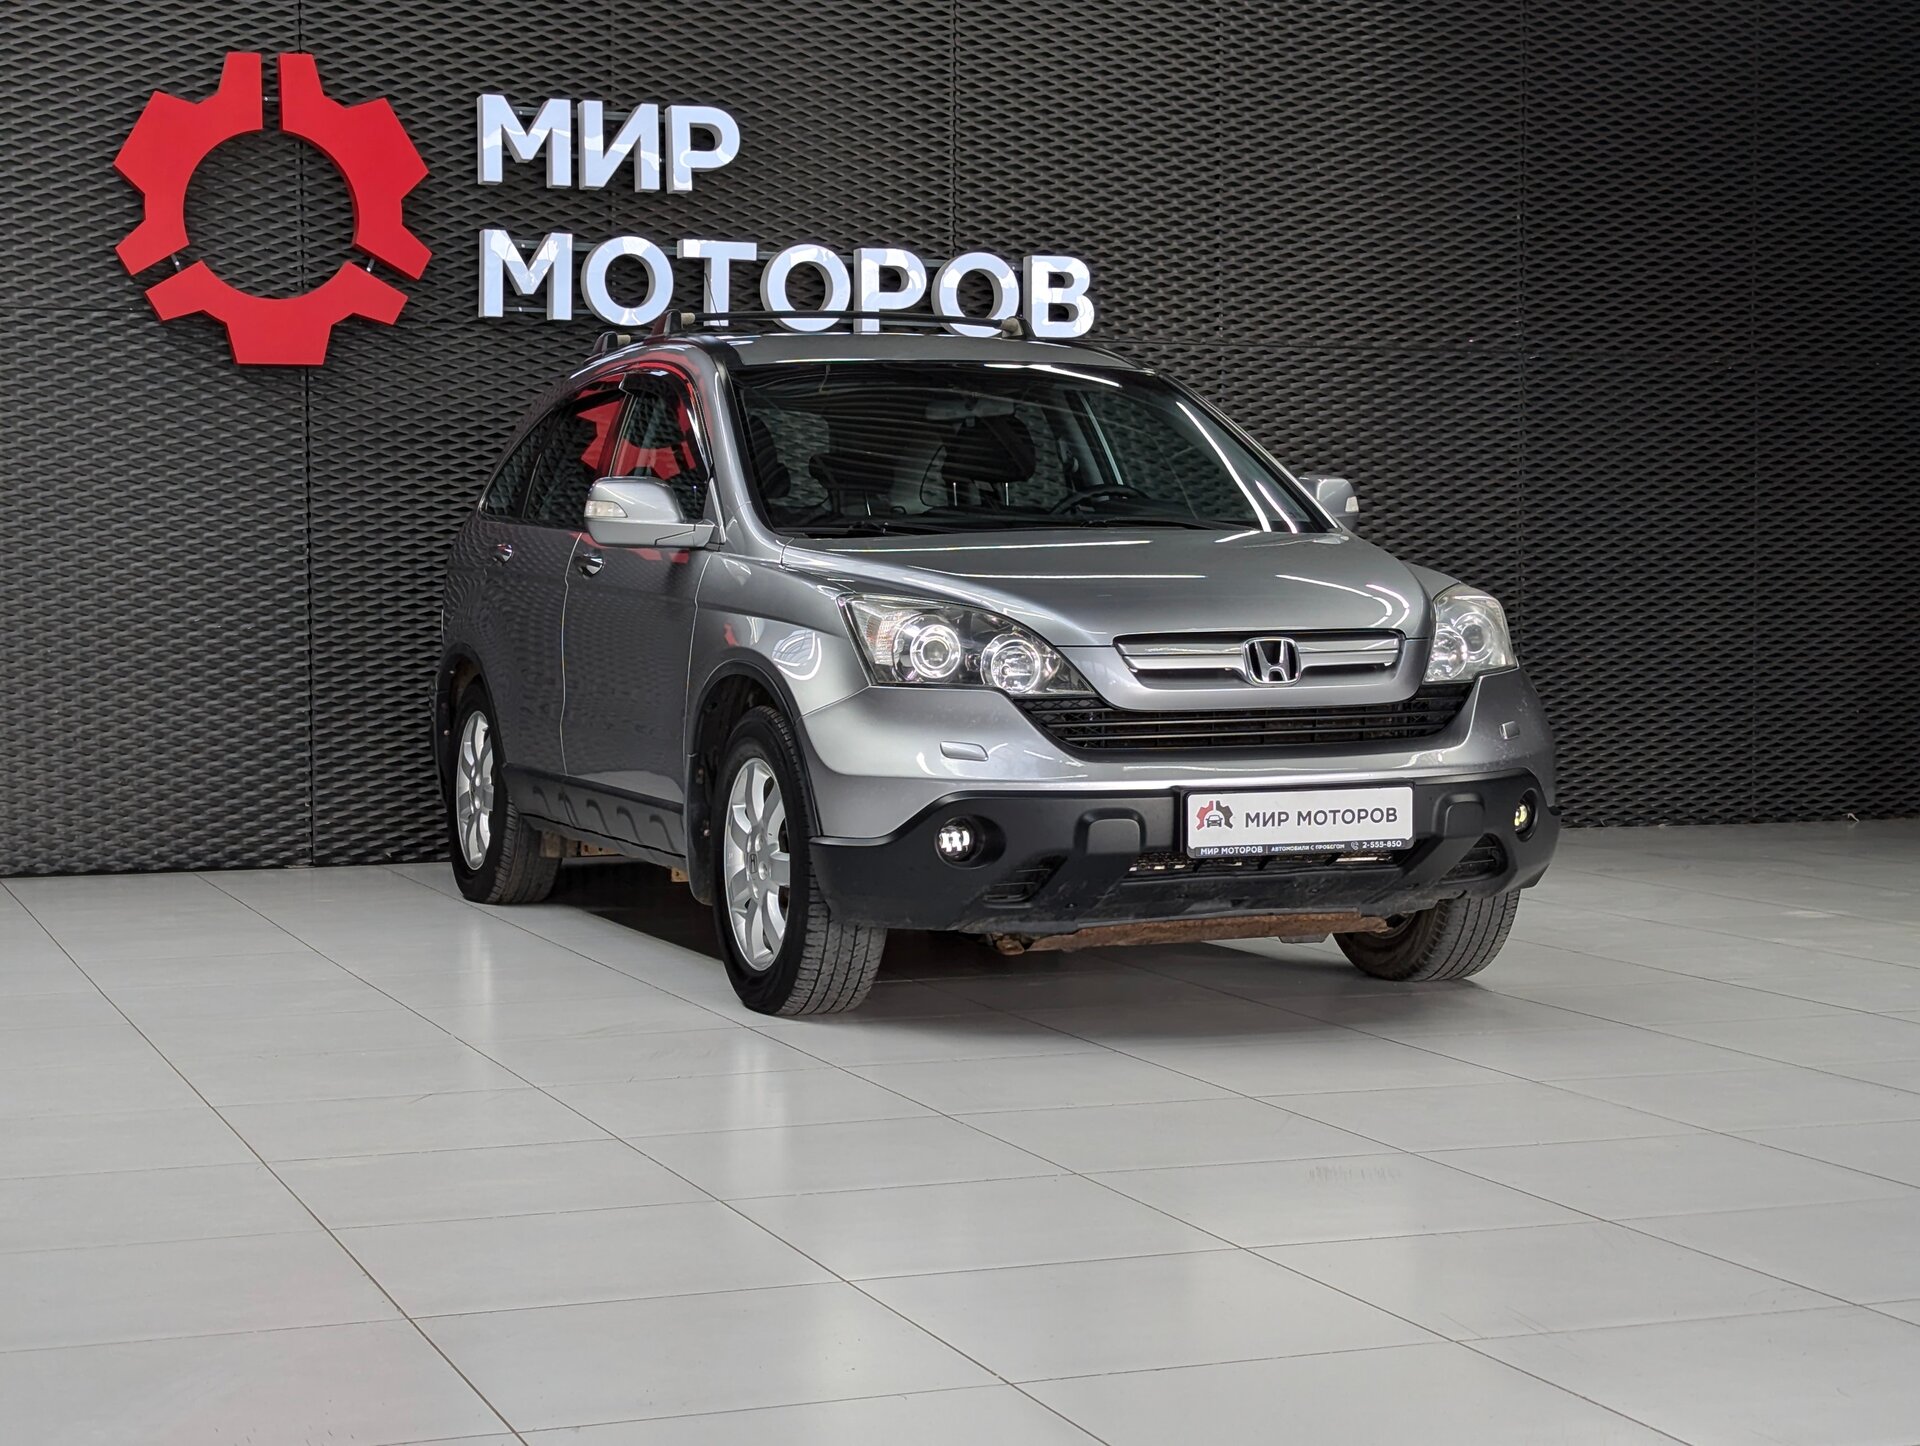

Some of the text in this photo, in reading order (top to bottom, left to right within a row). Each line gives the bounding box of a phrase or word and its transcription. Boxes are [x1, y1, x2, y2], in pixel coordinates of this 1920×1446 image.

[477, 94, 740, 194] МИР
[478, 229, 1094, 339] МОТОРОВ
[1245, 807, 1398, 828] МИР МОТОРОВ
[1200, 845, 1264, 856] МИР МОТОРОВ
[1271, 844, 1310, 852] АВТОМОБИЛИ
[1362, 840, 1402, 849] 2-555-850
